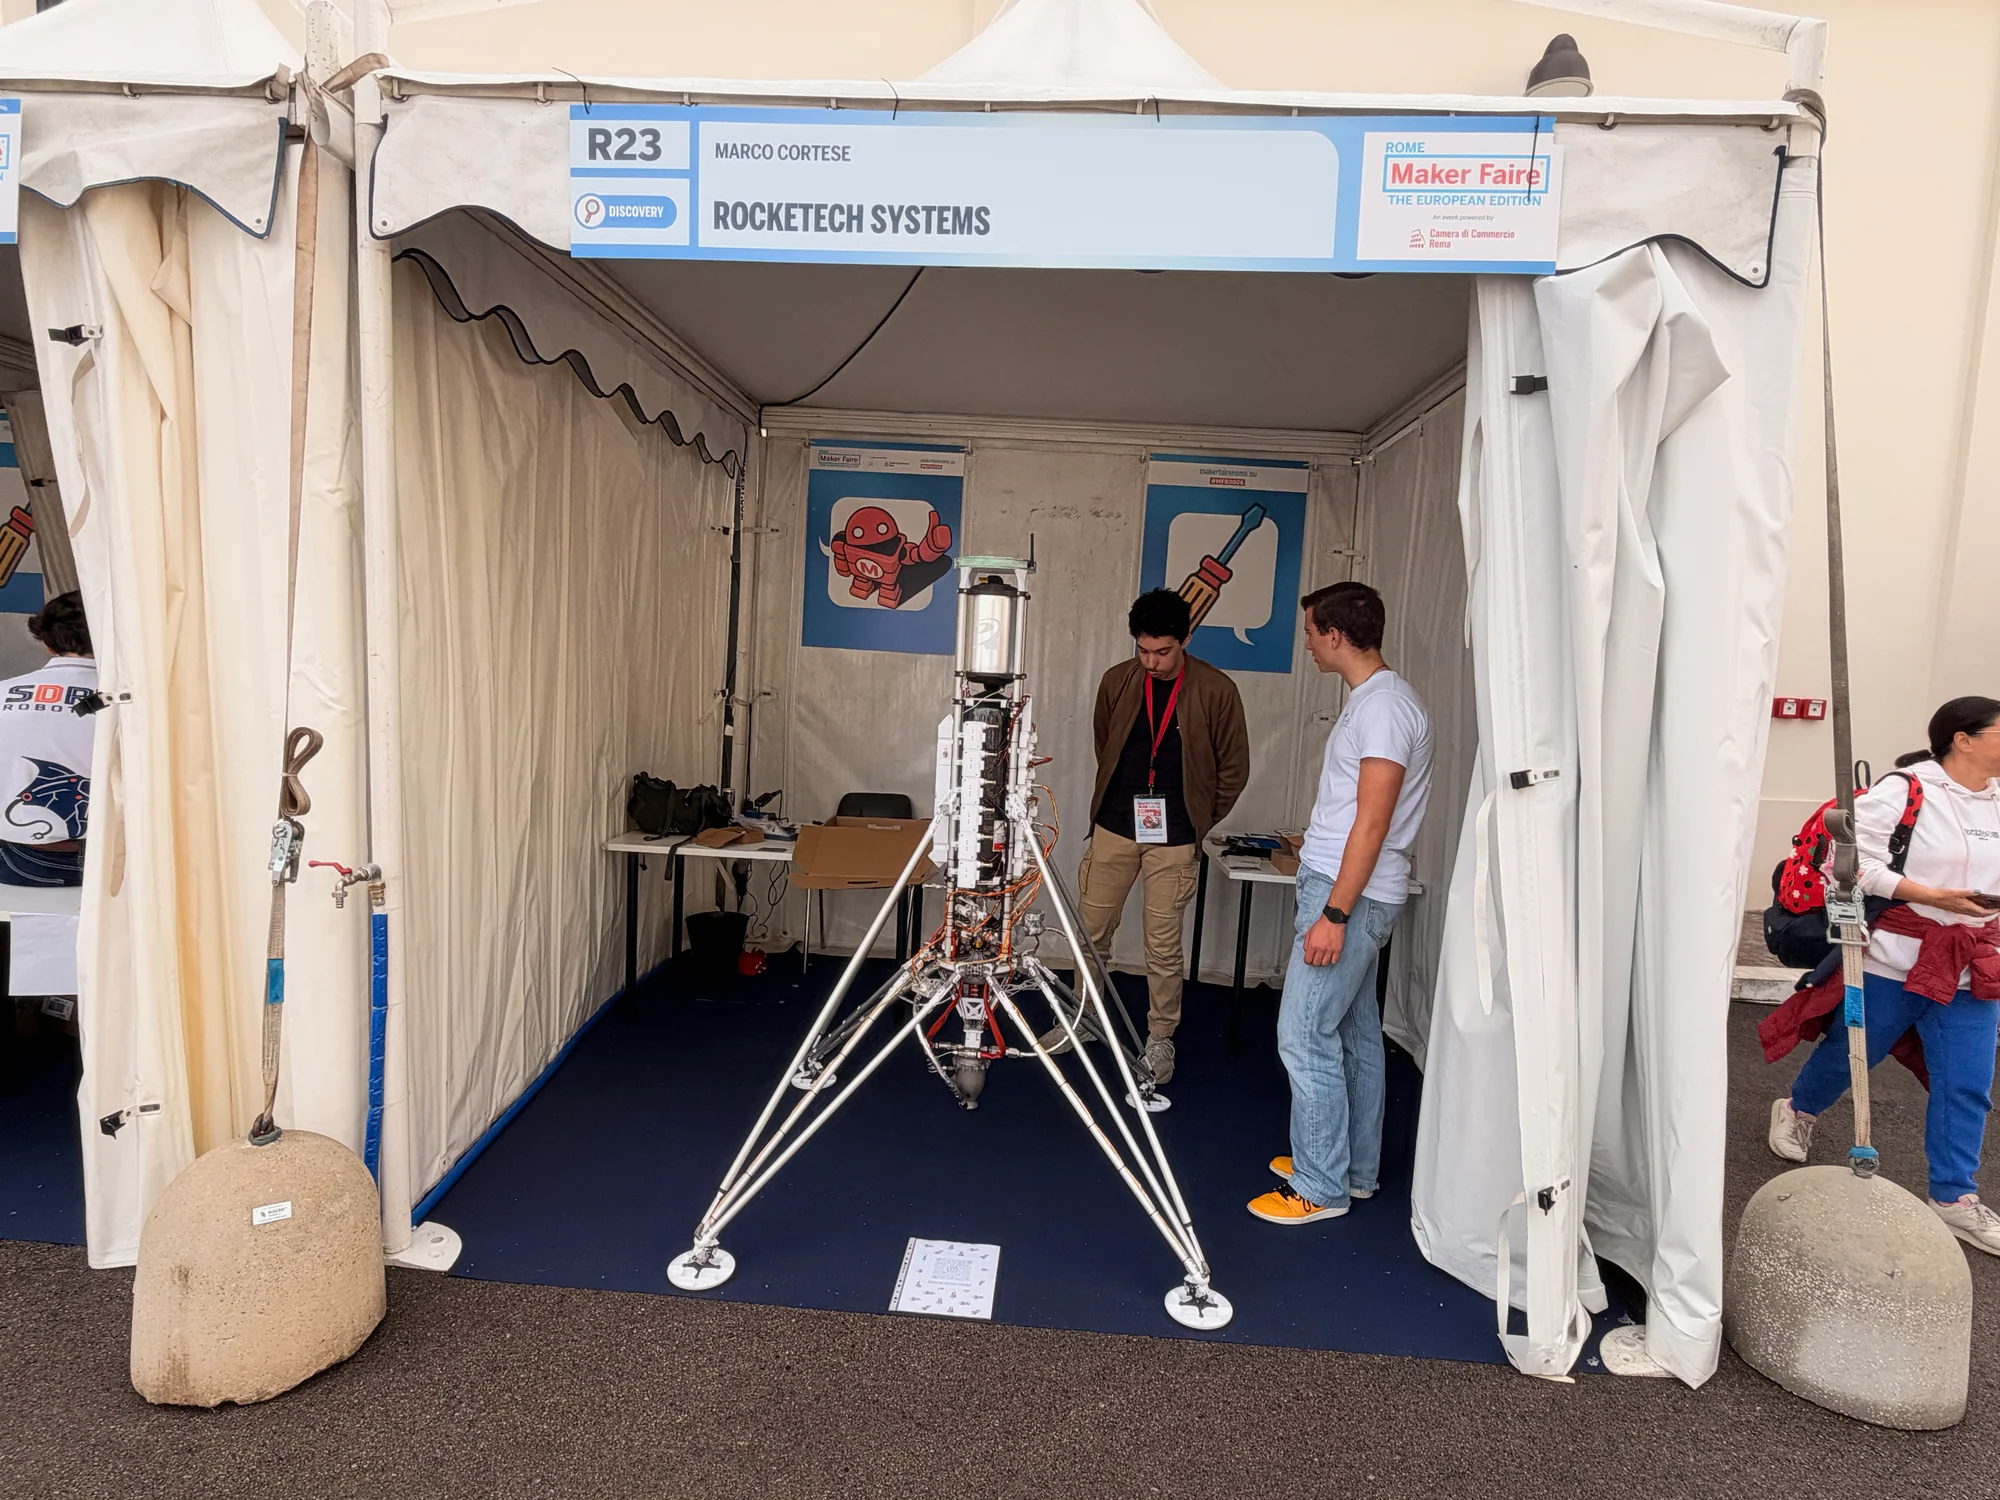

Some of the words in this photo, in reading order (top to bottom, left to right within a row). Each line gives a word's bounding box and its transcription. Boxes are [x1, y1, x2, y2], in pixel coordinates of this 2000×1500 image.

[588, 128, 662, 161] R23
[1385, 142, 1425, 153] ROME
[715, 143, 773, 160] MARCO
[777, 144, 851, 162] CORTESE
[1391, 162, 1471, 184] Maker
[1479, 163, 1541, 185] Faire
[1388, 195, 1412, 205] THE
[1416, 195, 1485, 206] EUROPEAN
[1489, 196, 1541, 206] EDITION
[608, 206, 664, 218] DISCOVERY
[714, 201, 863, 233] ROCKETECH
[870, 205, 990, 236] SYSTEMS
[1430, 229, 1459, 238] Camera
[1462, 229, 1469, 238] di
[1471, 229, 1515, 238] Commercio
[1429, 239, 1451, 248] Roma
[820, 455, 841, 463] Maker
[860, 562, 878, 576] M
